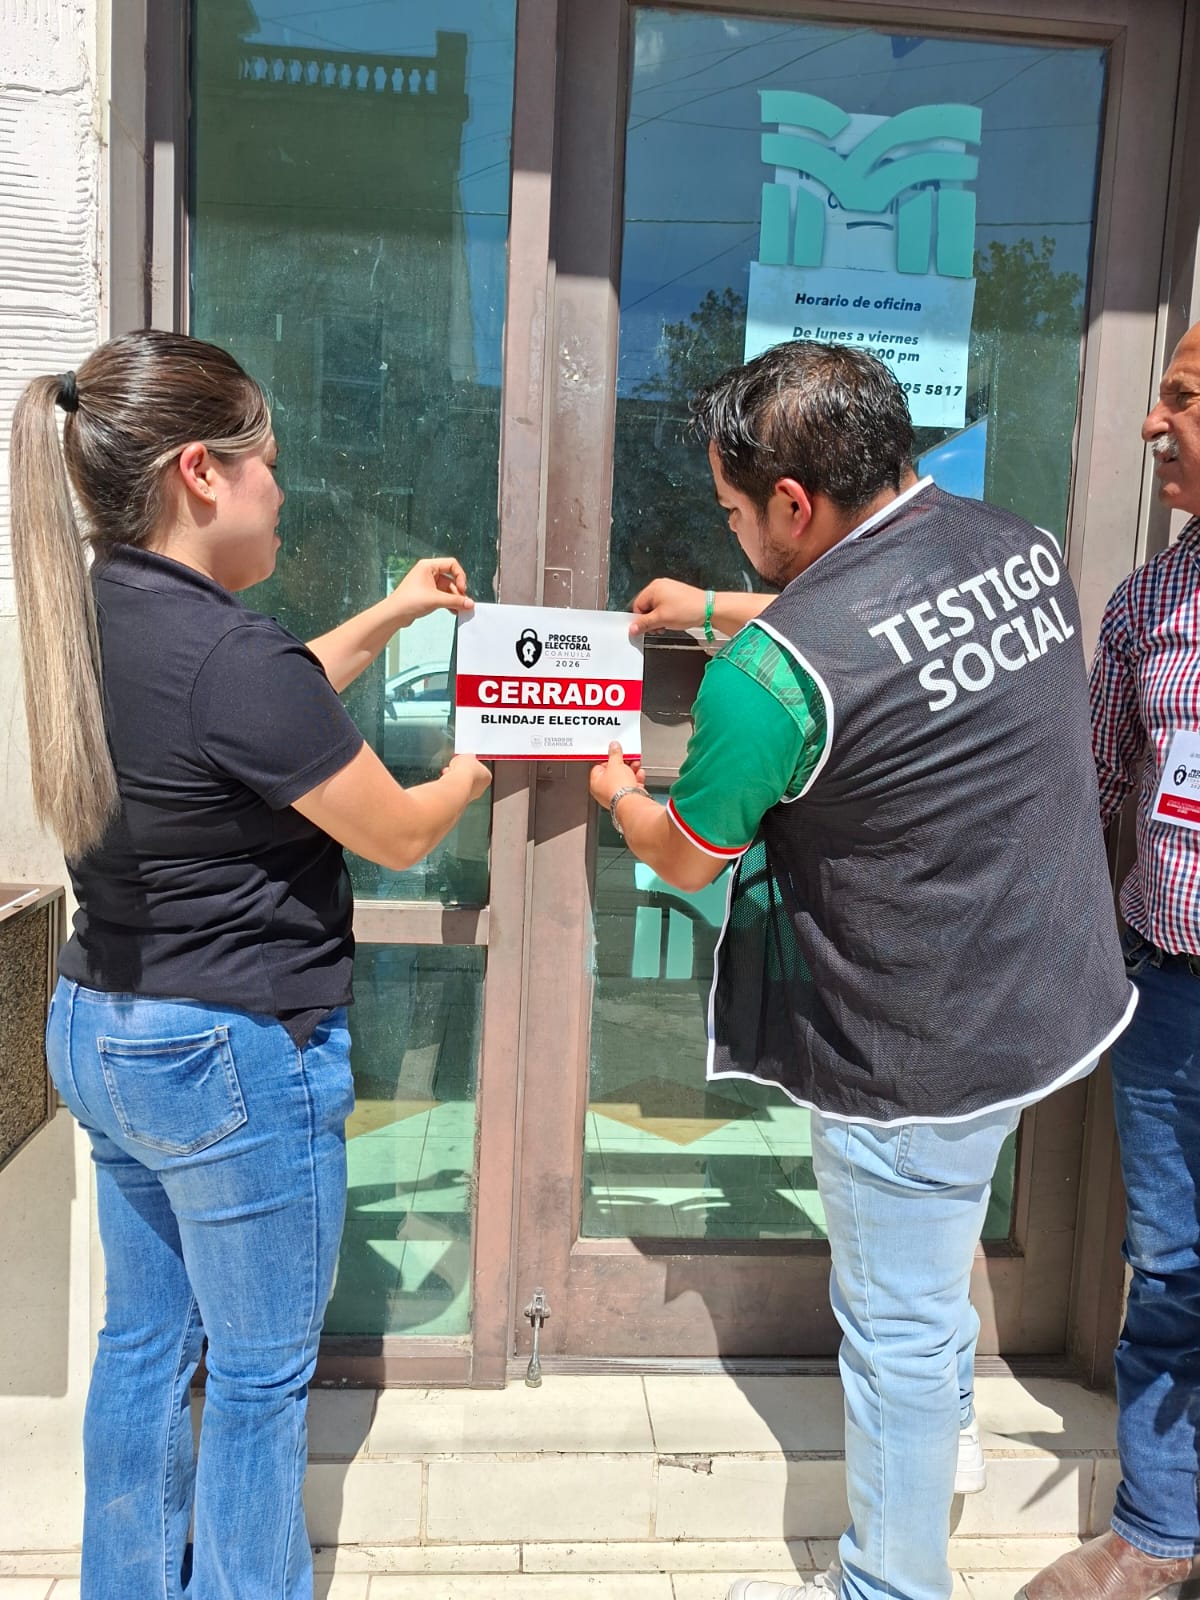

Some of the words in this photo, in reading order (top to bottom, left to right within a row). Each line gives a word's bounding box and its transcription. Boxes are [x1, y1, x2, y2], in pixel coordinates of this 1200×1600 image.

[795, 292, 849, 308] Horario
[852, 295, 870, 309] de
[873, 297, 922, 312] oficina
[792, 326, 812, 339] De
[814, 327, 853, 341] lunes
[856, 333, 865, 342] a
[867, 330, 919, 345] viernes
[897, 350, 920, 363] pm
[925, 384, 963, 397] 5817
[868, 543, 1061, 665] TESTIGO
[548, 634, 589, 643] PROCESO
[544, 641, 592, 651] ELECTORAL
[544, 650, 592, 658] COAHUILA
[918, 597, 1075, 712] SOCIAL
[555, 660, 580, 668] 2026
[477, 680, 626, 707] CERRADO
[481, 714, 545, 725] BLINDAJE
[548, 715, 621, 726] ELECTORAL
